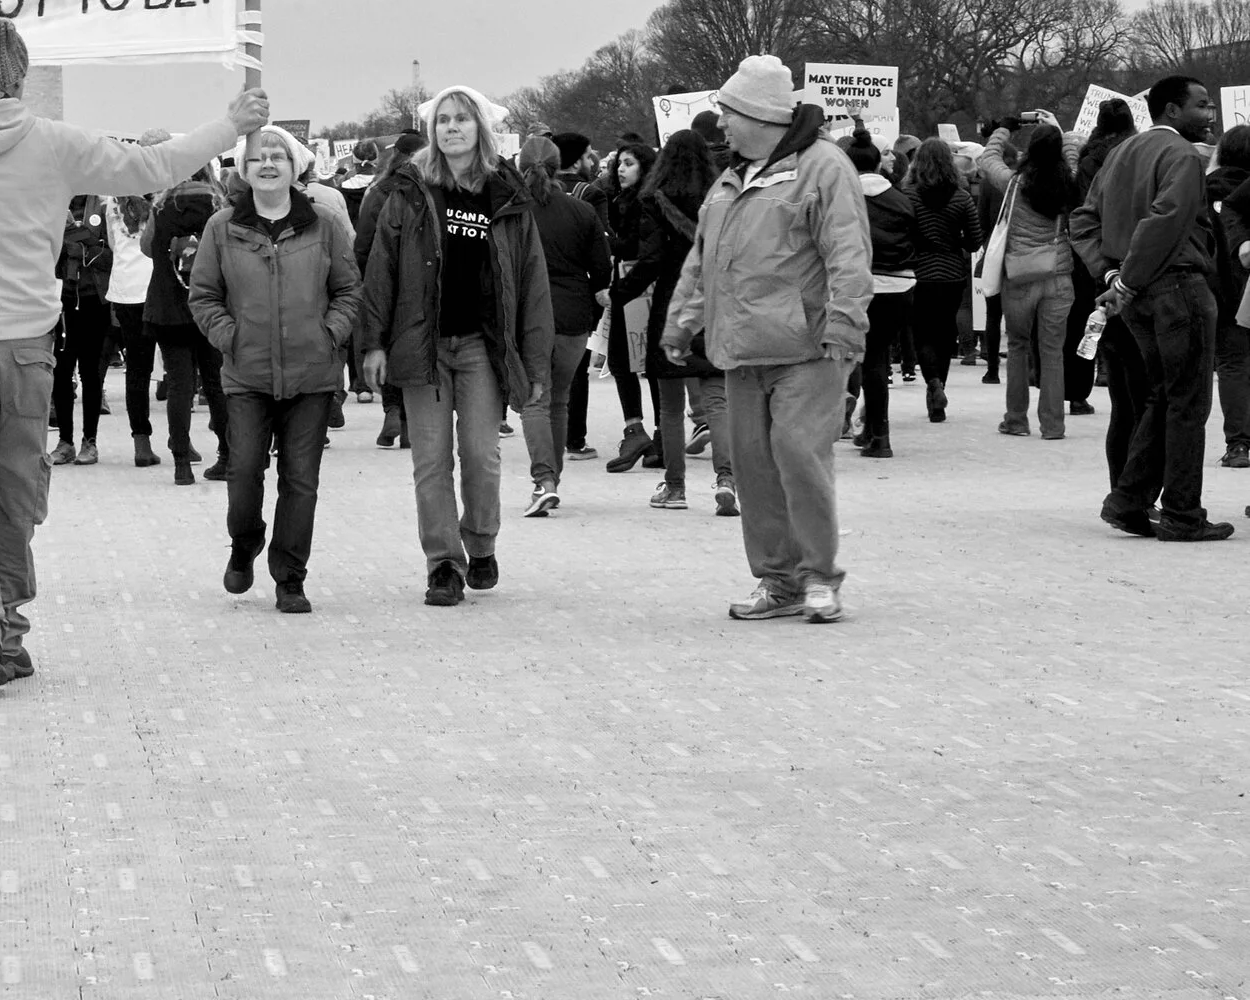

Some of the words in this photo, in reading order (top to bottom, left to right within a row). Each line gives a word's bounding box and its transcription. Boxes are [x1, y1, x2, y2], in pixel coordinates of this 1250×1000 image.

[808, 74, 832, 84] MAY
[834, 75, 854, 85] THE
[856, 76, 894, 88] FORCE
[821, 86, 834, 95] BE
[836, 87, 865, 97] WITH
[868, 88, 881, 98] US
[455, 209, 477, 221] CAN
[462, 226, 477, 238] TO
